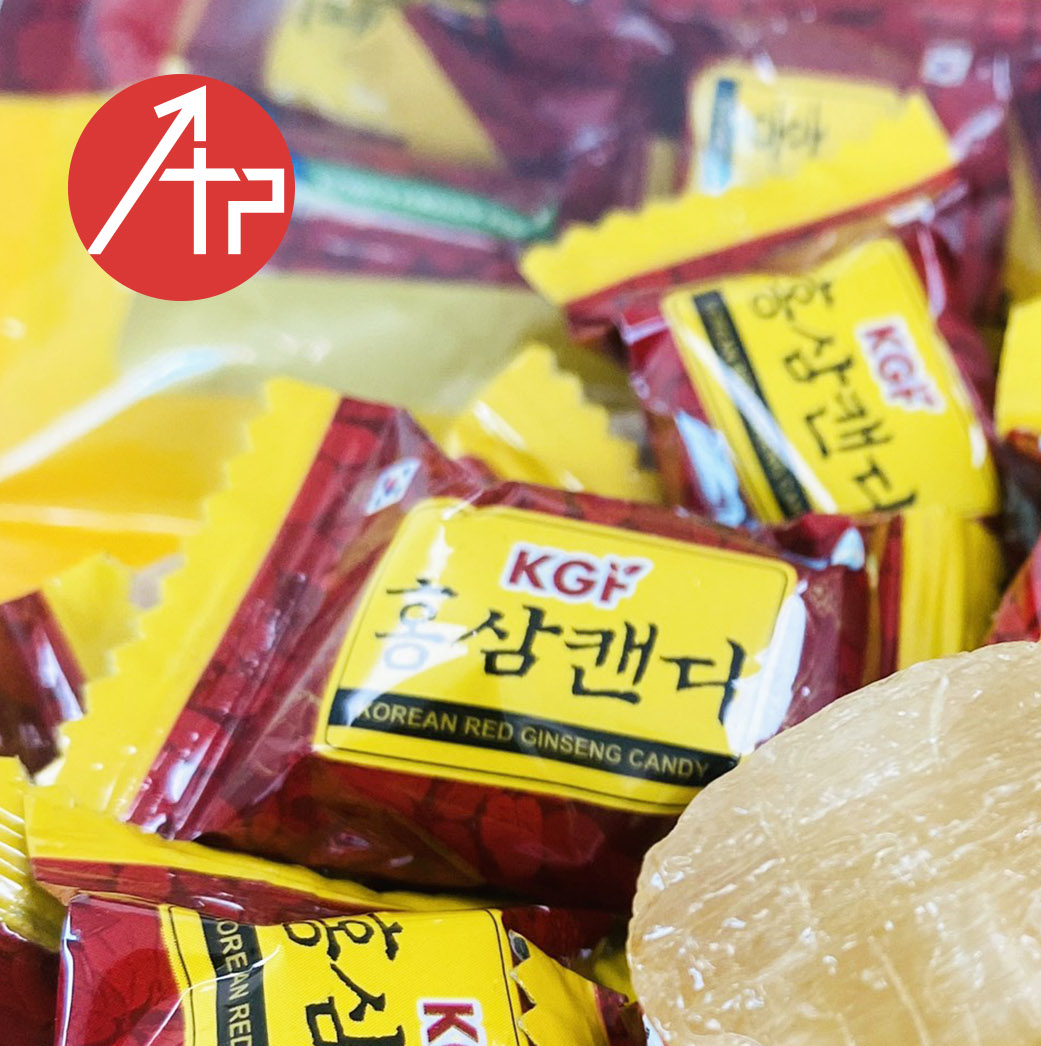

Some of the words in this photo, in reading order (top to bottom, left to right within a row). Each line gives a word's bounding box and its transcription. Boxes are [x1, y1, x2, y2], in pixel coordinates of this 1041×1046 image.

[507, 549, 644, 604] KGF
[375, 577, 747, 726] 홍삼캔디
[464, 717, 514, 743] RED
[520, 726, 622, 765] GINSENG
[628, 750, 710, 780] CANDY
[216, 920, 250, 999] OREAN
